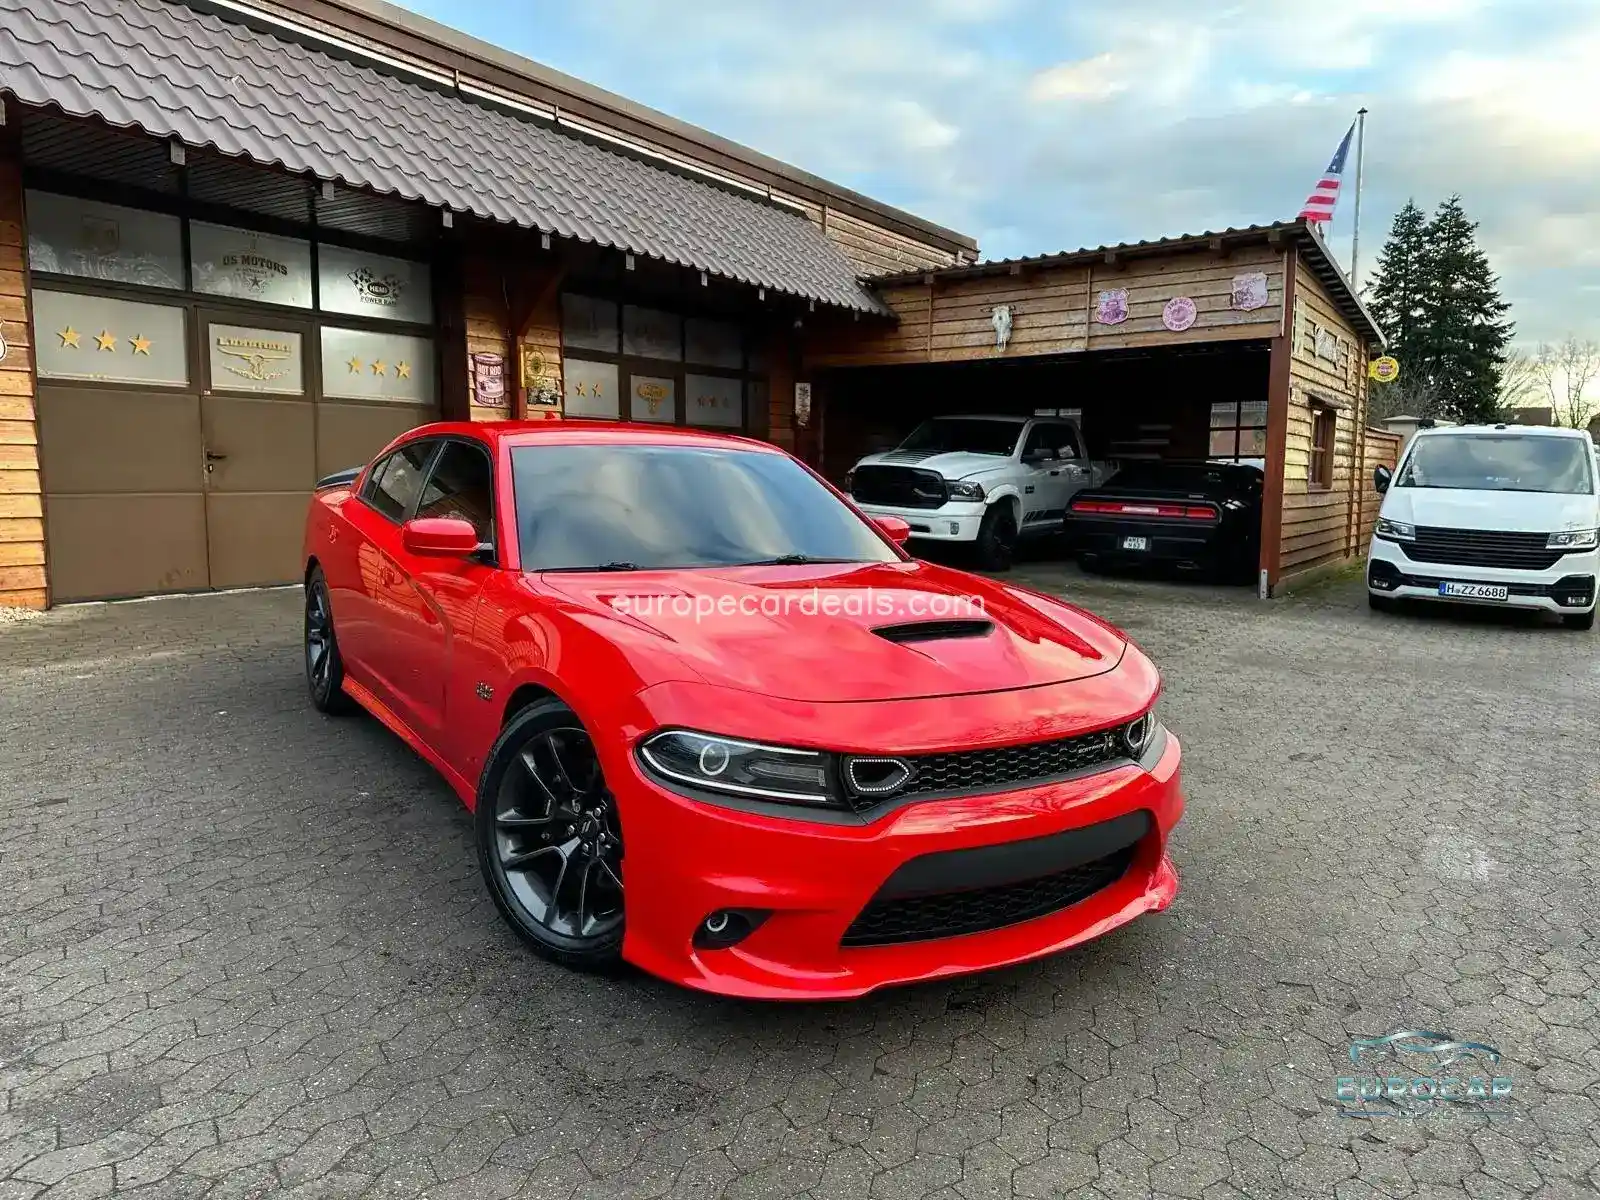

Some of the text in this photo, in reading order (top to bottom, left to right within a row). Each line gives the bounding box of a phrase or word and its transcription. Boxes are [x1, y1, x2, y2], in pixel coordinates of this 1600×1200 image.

[223, 254, 288, 276] US MOTORS
[369, 285, 388, 293] HEMI
[360, 296, 384, 305] POWER
[477, 364, 502, 376] HOT ROD
[1446, 584, 1506, 598] H ZZ 6688
